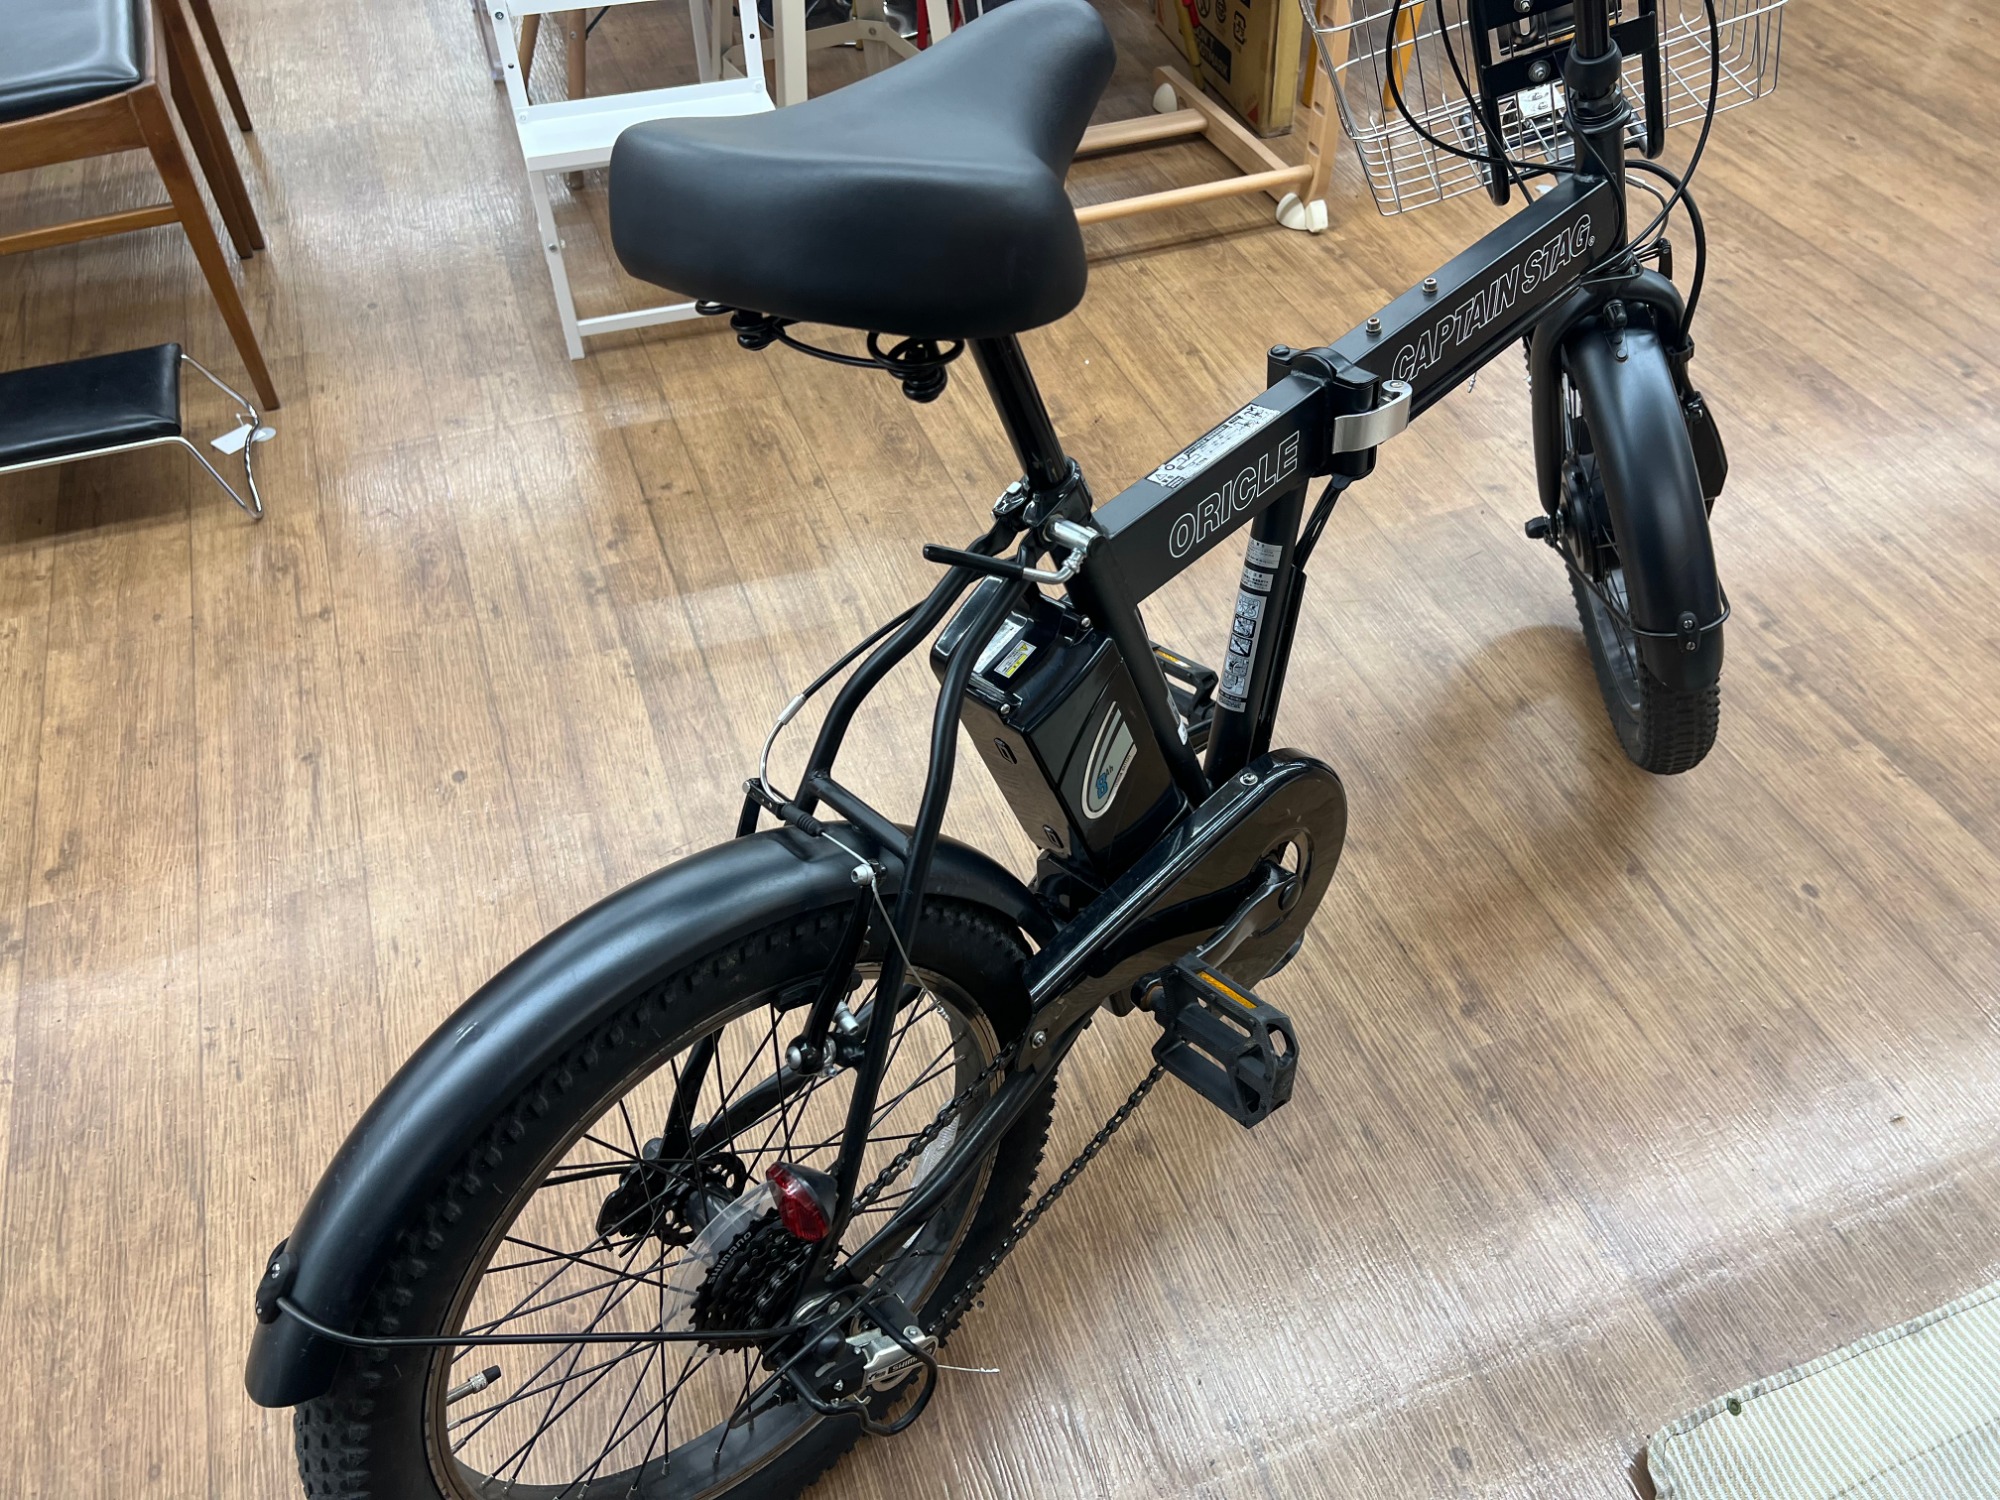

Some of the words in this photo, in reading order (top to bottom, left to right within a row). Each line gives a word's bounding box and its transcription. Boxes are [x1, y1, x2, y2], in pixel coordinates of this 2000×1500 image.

[1392, 264, 1520, 383] CAPTAIN
[1169, 429, 1300, 558] ORICLE
[707, 1231, 752, 1285] SHIMANO
